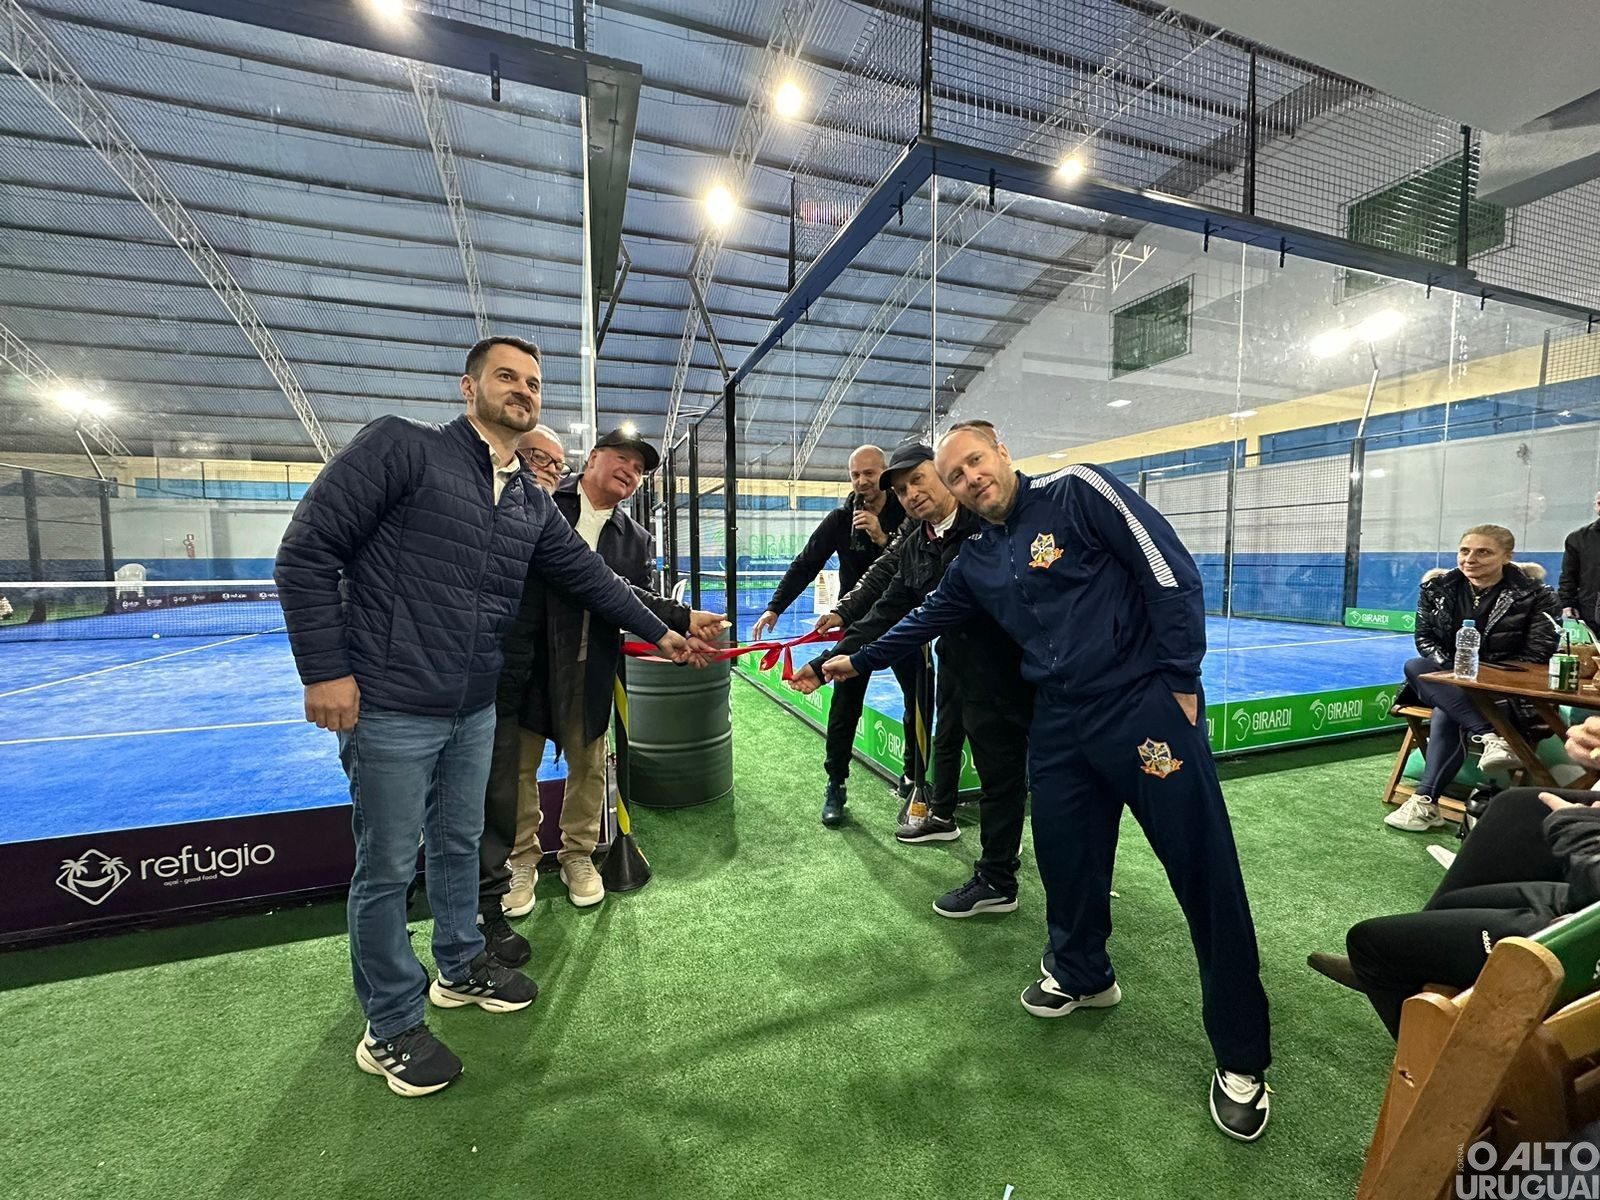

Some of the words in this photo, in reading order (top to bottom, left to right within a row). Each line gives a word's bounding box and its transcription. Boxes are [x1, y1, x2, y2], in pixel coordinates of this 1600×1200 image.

[1361, 613, 1389, 624] GIRARDI
[1252, 708, 1292, 731] GIRARDI
[1327, 699, 1363, 721] GIRARDI
[140, 843, 276, 880] refúgio
[184, 875, 202, 885] good
[202, 873, 218, 881] food
